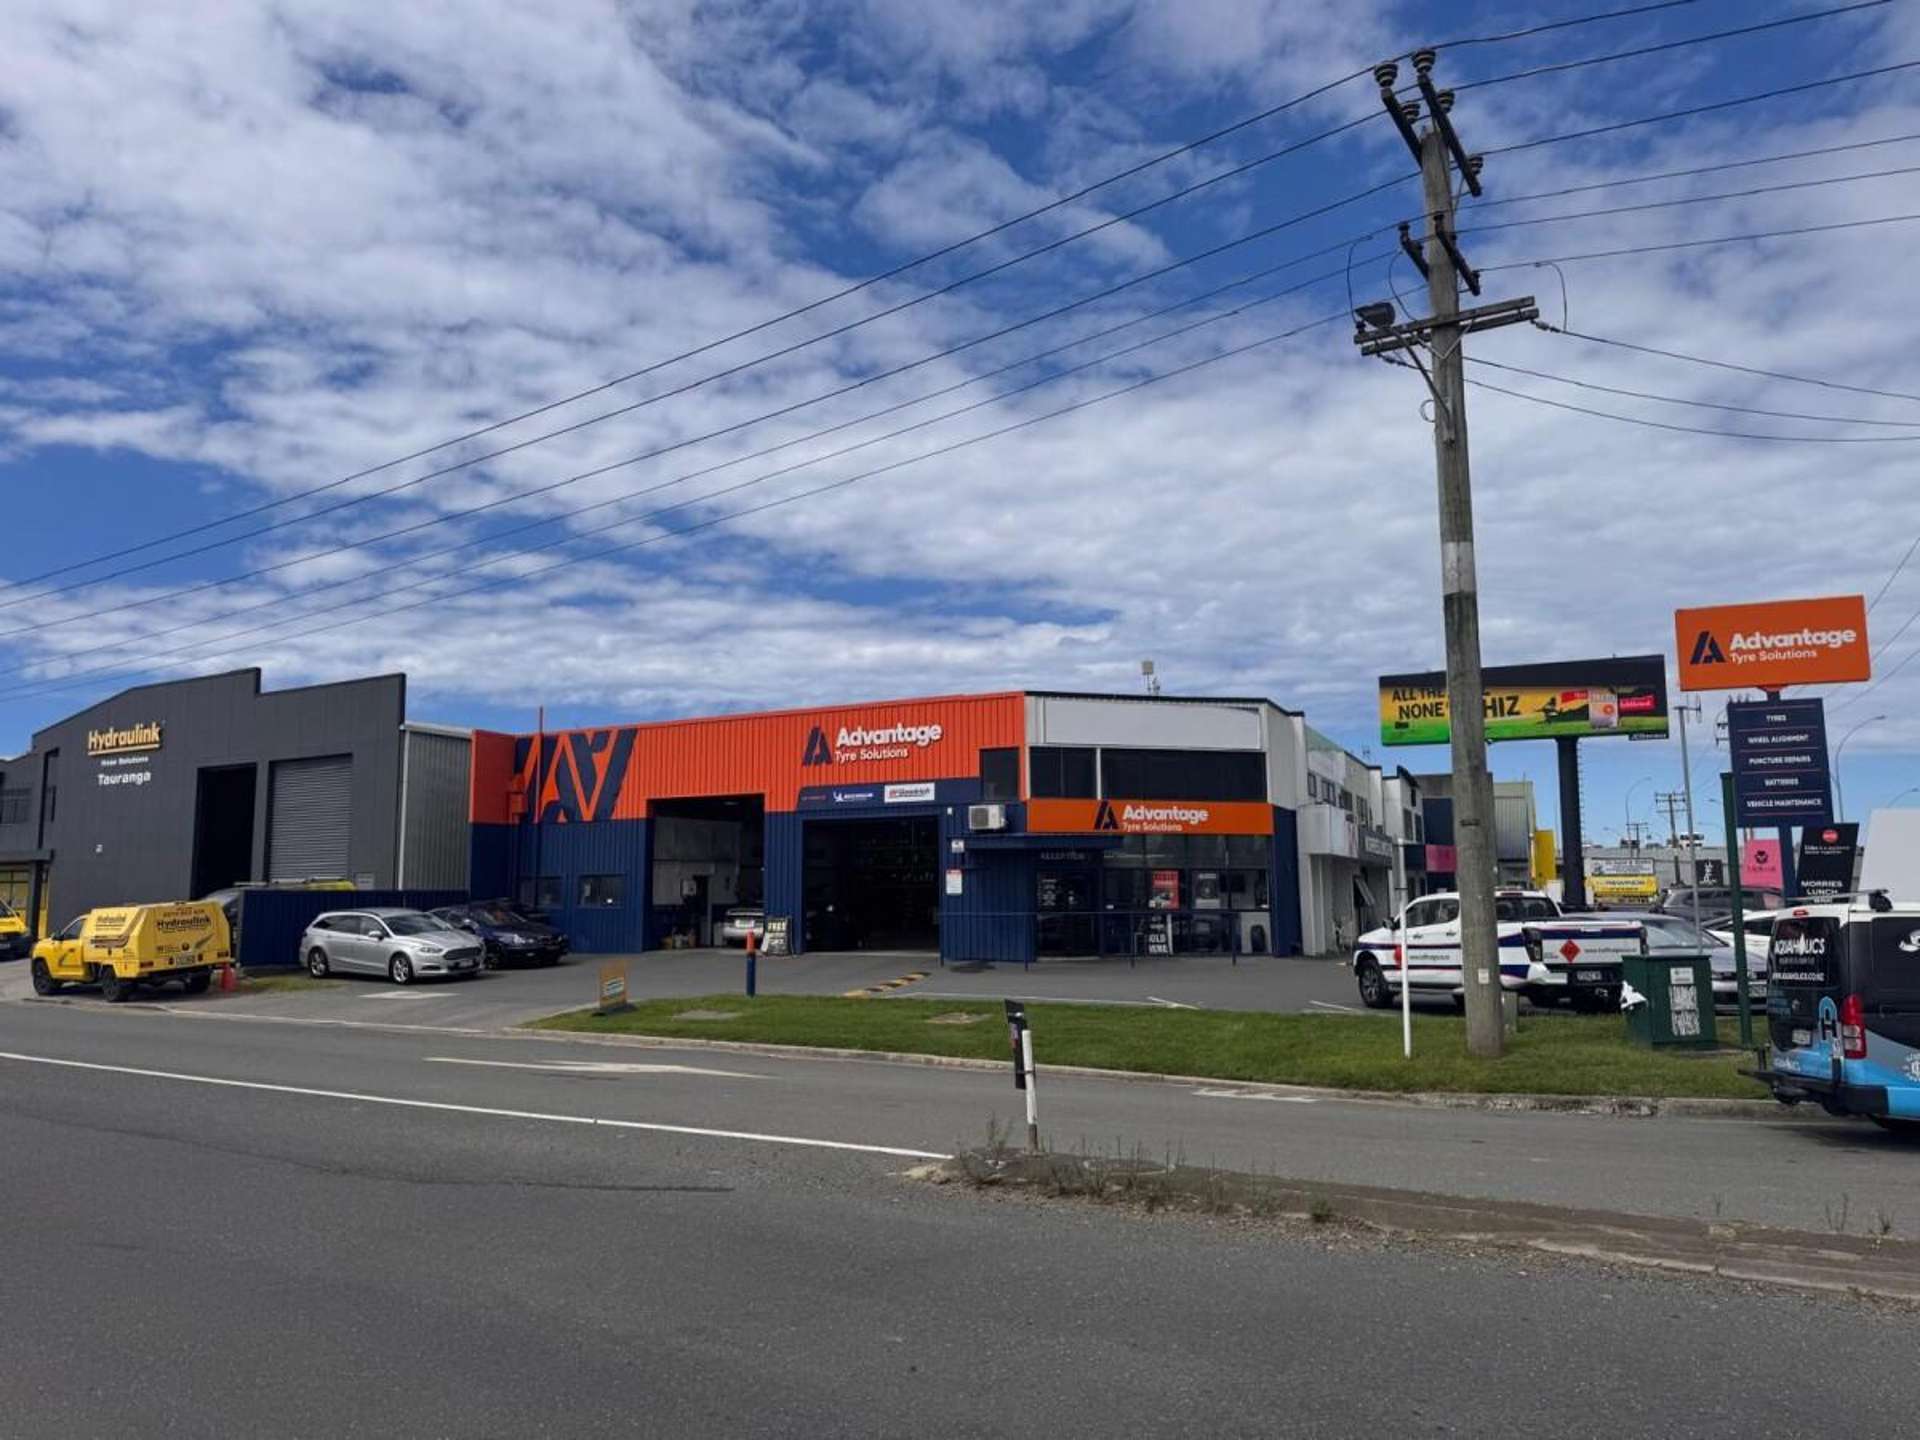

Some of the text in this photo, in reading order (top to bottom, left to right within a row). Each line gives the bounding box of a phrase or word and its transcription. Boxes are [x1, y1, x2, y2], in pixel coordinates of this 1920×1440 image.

[1730, 628, 1857, 649] Advantage
[1730, 649, 1817, 665] Tyre Solutions
[1392, 688, 1446, 702] ALL THE
[1399, 702, 1445, 719] NONE
[88, 721, 161, 751] Hydraulink
[836, 722, 943, 748] Advantage
[1771, 734, 1809, 743] ALIGNMENT
[834, 747, 908, 764] Tyre Solutions
[1749, 756, 1783, 764] PUNCTURE
[97, 771, 152, 786] Tauranga
[1764, 778, 1799, 786] BATTERIES
[1747, 798, 1823, 807] VEHICLE MAINTENANCE
[1123, 804, 1209, 825] Advantage
[1122, 821, 1183, 832] Tyre Solutions
[1806, 888, 1838, 896] LUNCH
[156, 914, 211, 930] Hydraulink
